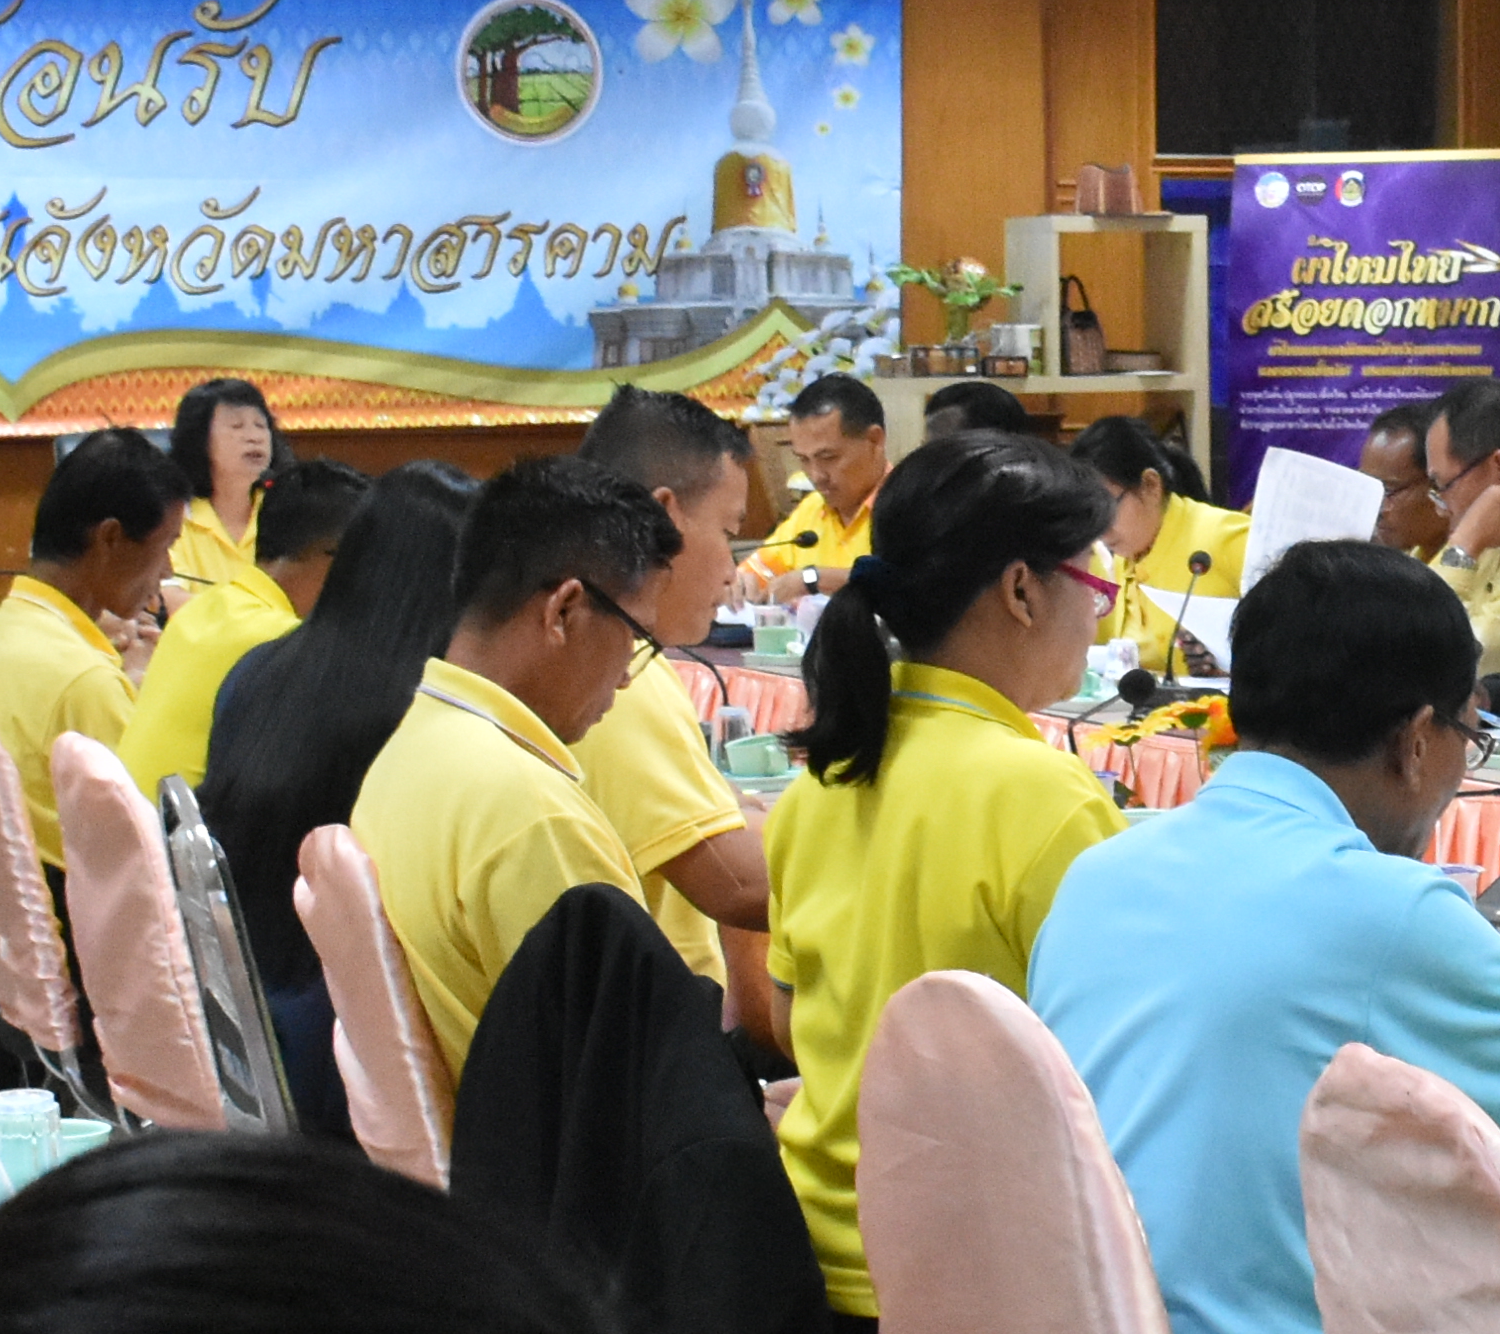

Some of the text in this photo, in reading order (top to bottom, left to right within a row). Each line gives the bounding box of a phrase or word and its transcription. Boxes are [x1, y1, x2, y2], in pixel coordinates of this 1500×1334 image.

[1291, 234, 1464, 285] ผ้าไหมไทย
[1242, 288, 1500, 336] สร้อยดอกหมาก
